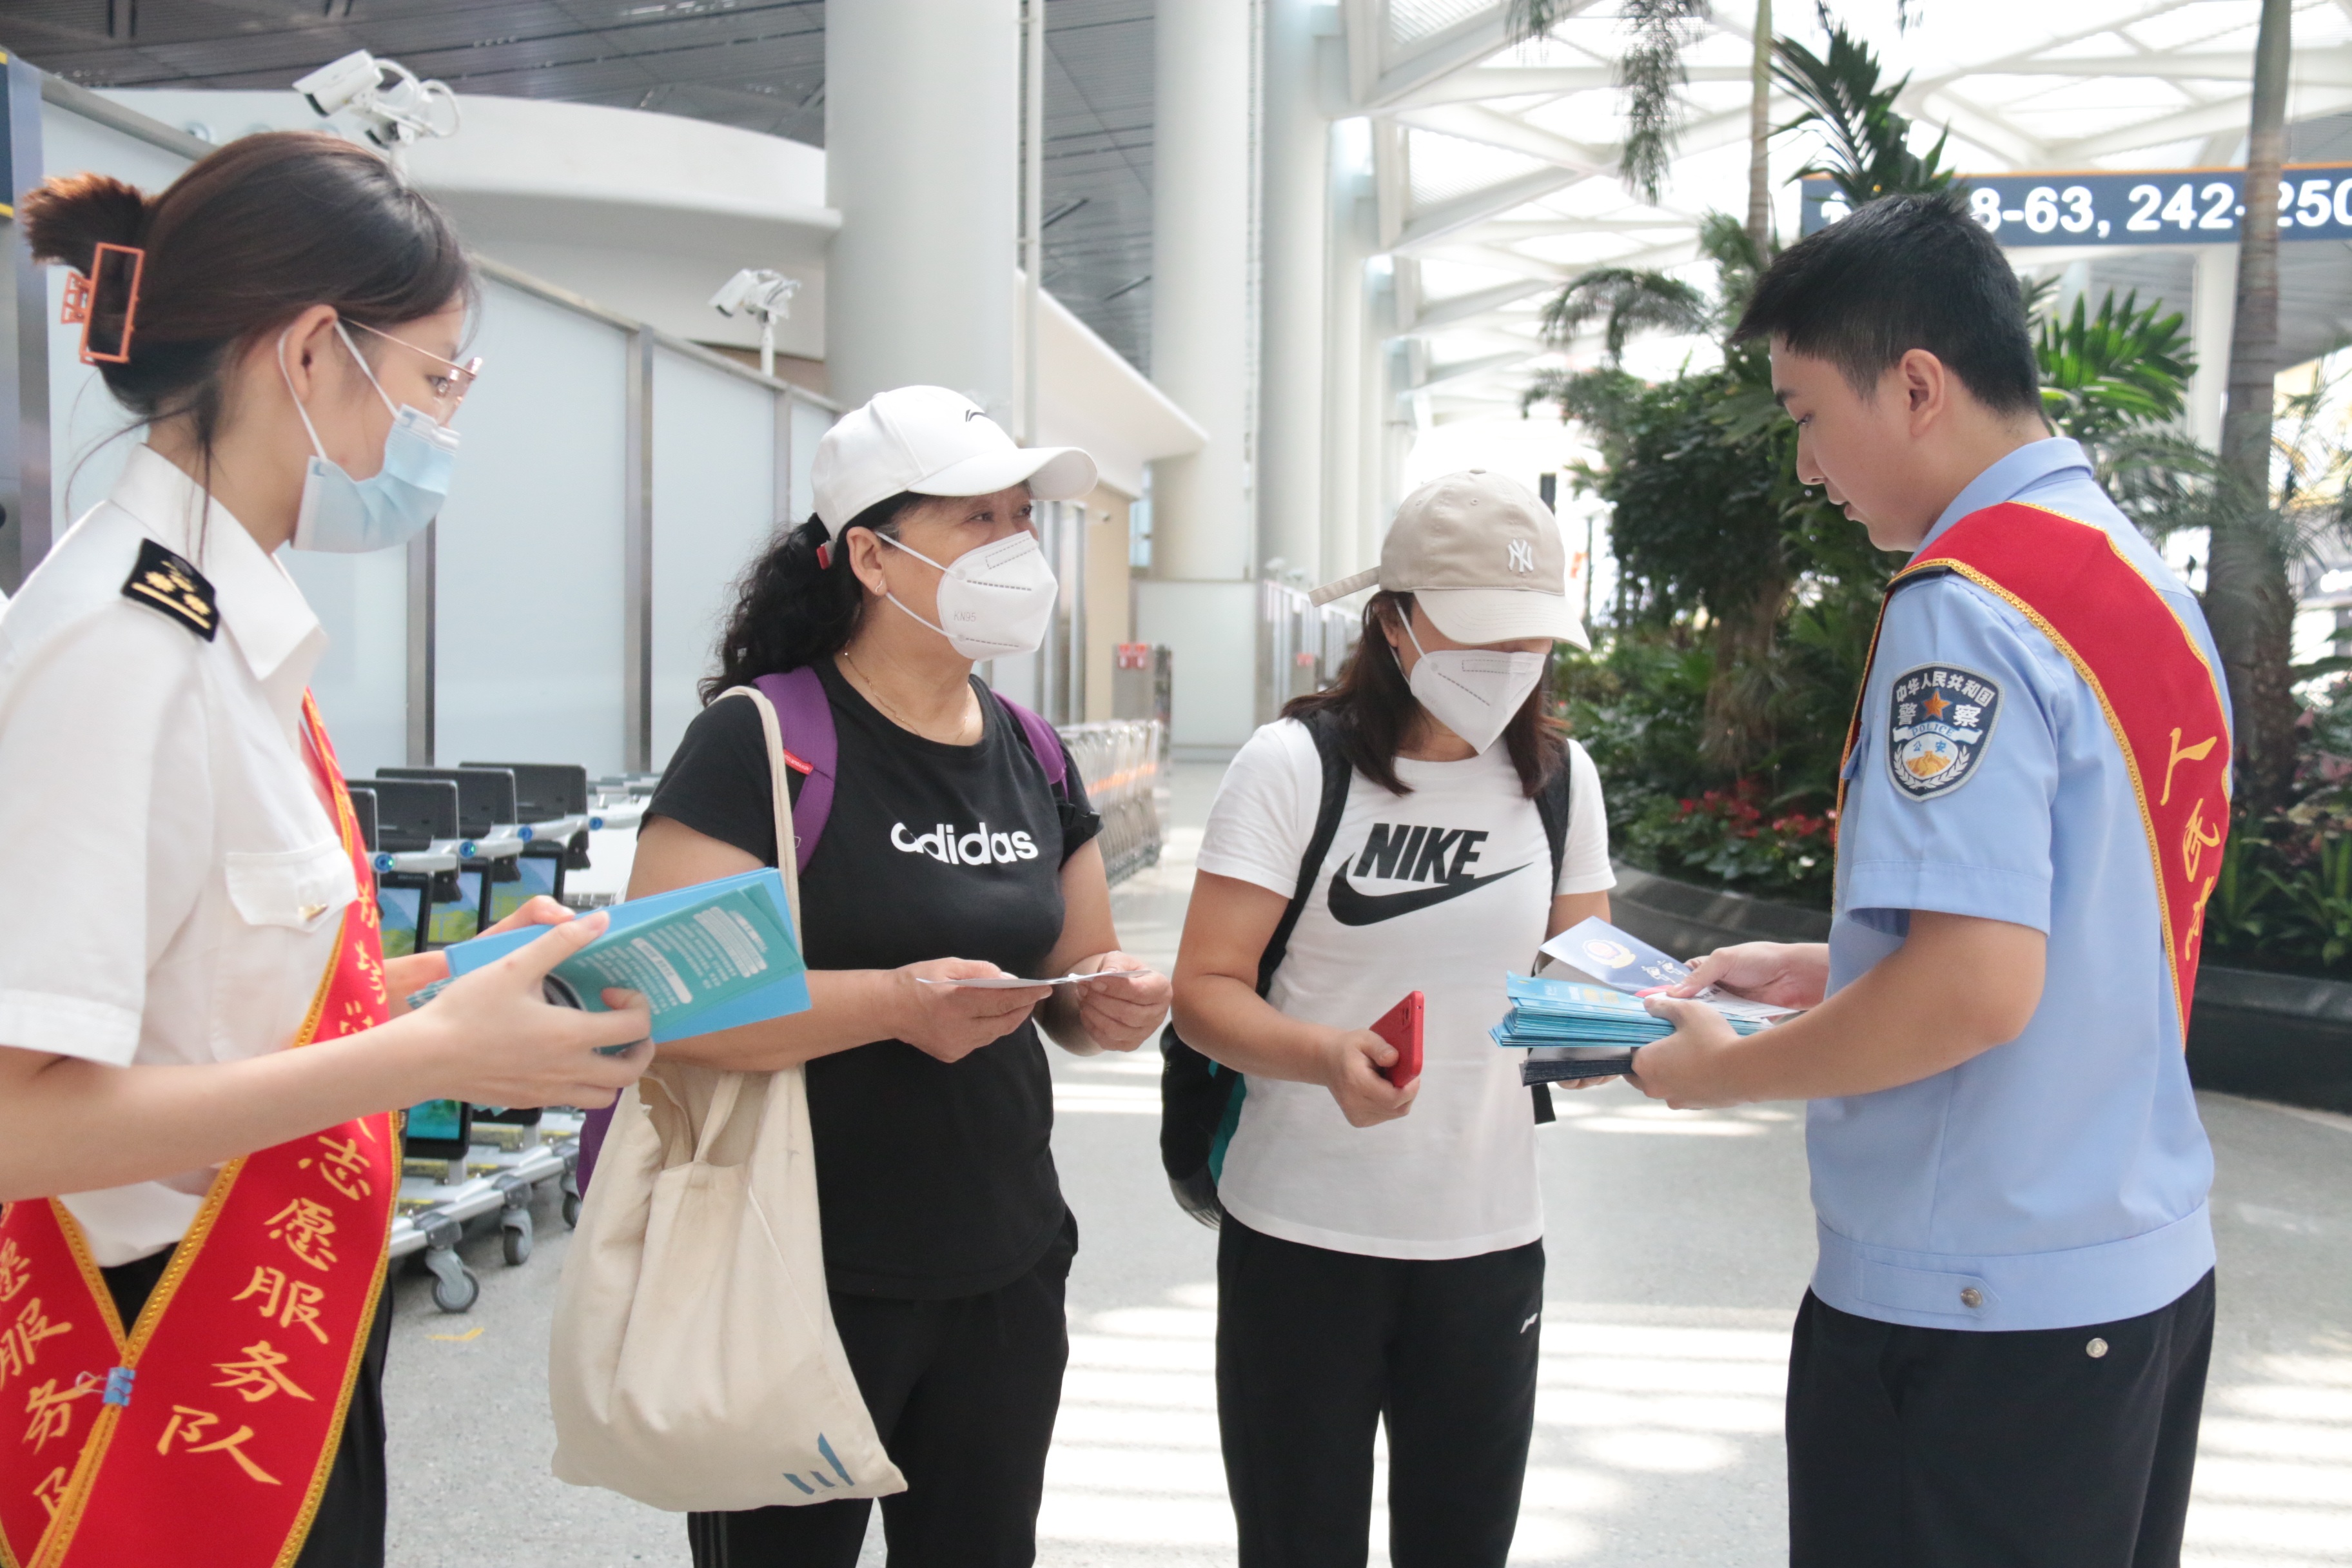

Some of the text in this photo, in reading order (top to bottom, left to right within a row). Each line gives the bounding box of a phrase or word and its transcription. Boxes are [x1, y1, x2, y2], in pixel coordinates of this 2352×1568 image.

[953, 610, 977, 623] KN95
[1896, 671, 1995, 708] 中华人民共和国
[1911, 721, 1955, 738] POLICE
[1912, 740, 1948, 754] 公安
[890, 821, 1039, 866] adidas
[1352, 822, 1489, 884] NIKE
[157, 1135, 372, 1485] 志愿服务队
